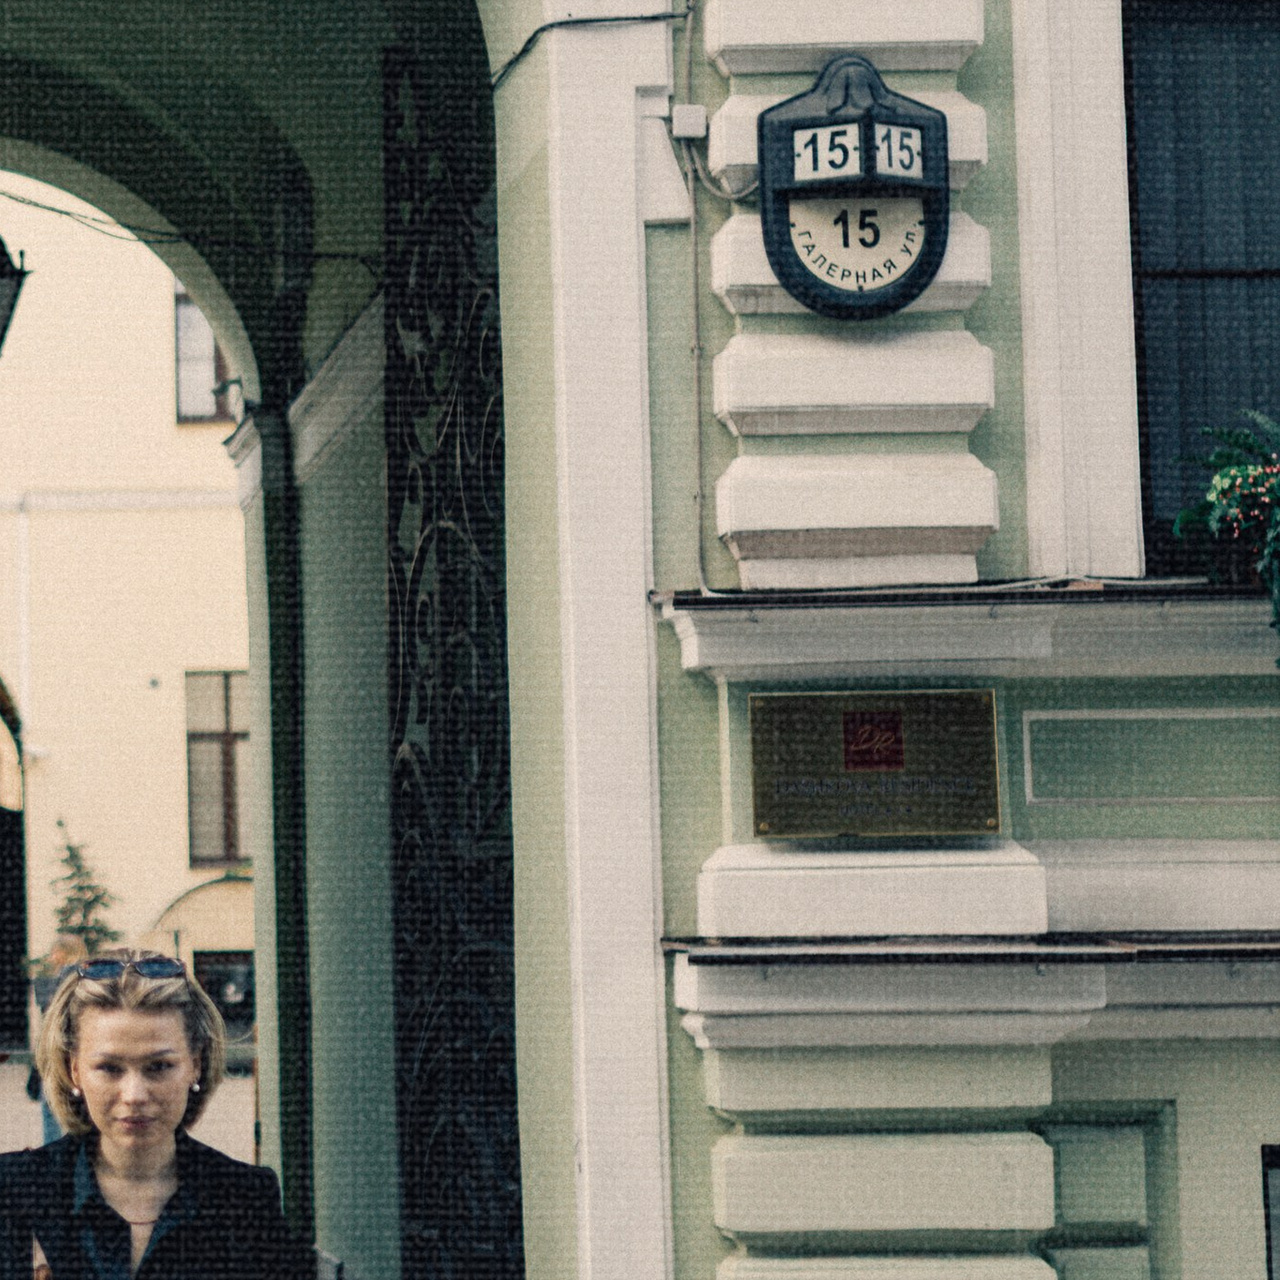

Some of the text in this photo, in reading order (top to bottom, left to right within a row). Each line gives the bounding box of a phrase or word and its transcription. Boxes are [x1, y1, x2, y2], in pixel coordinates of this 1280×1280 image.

[803, 129, 849, 171] 15
[881, 128, 914, 170] 15
[833, 209, 880, 248] 15
[798, 230, 897, 283] ГАЛЕРНАЯ
